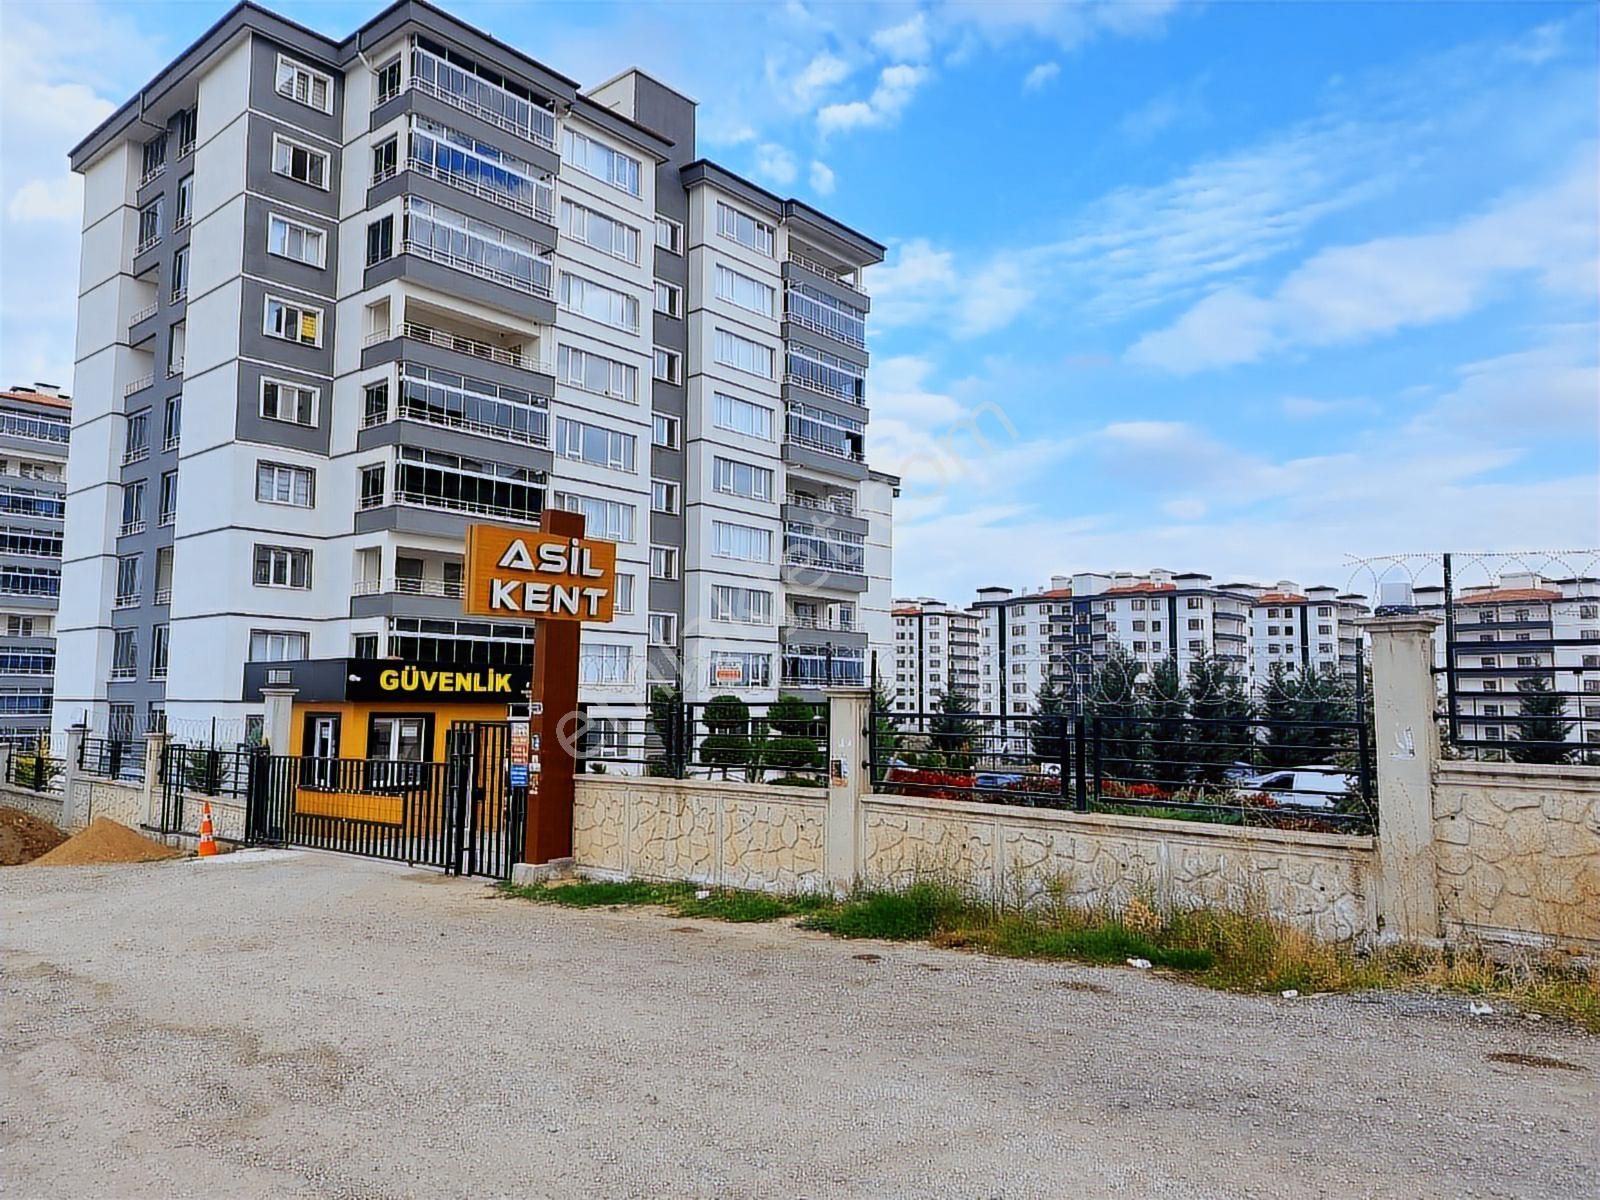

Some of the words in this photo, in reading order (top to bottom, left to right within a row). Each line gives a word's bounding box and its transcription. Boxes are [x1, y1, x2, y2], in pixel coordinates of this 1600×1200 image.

[498, 538, 605, 577] ASİL
[492, 578, 609, 616] KENT
[379, 665, 512, 692] GÜVENLİK
